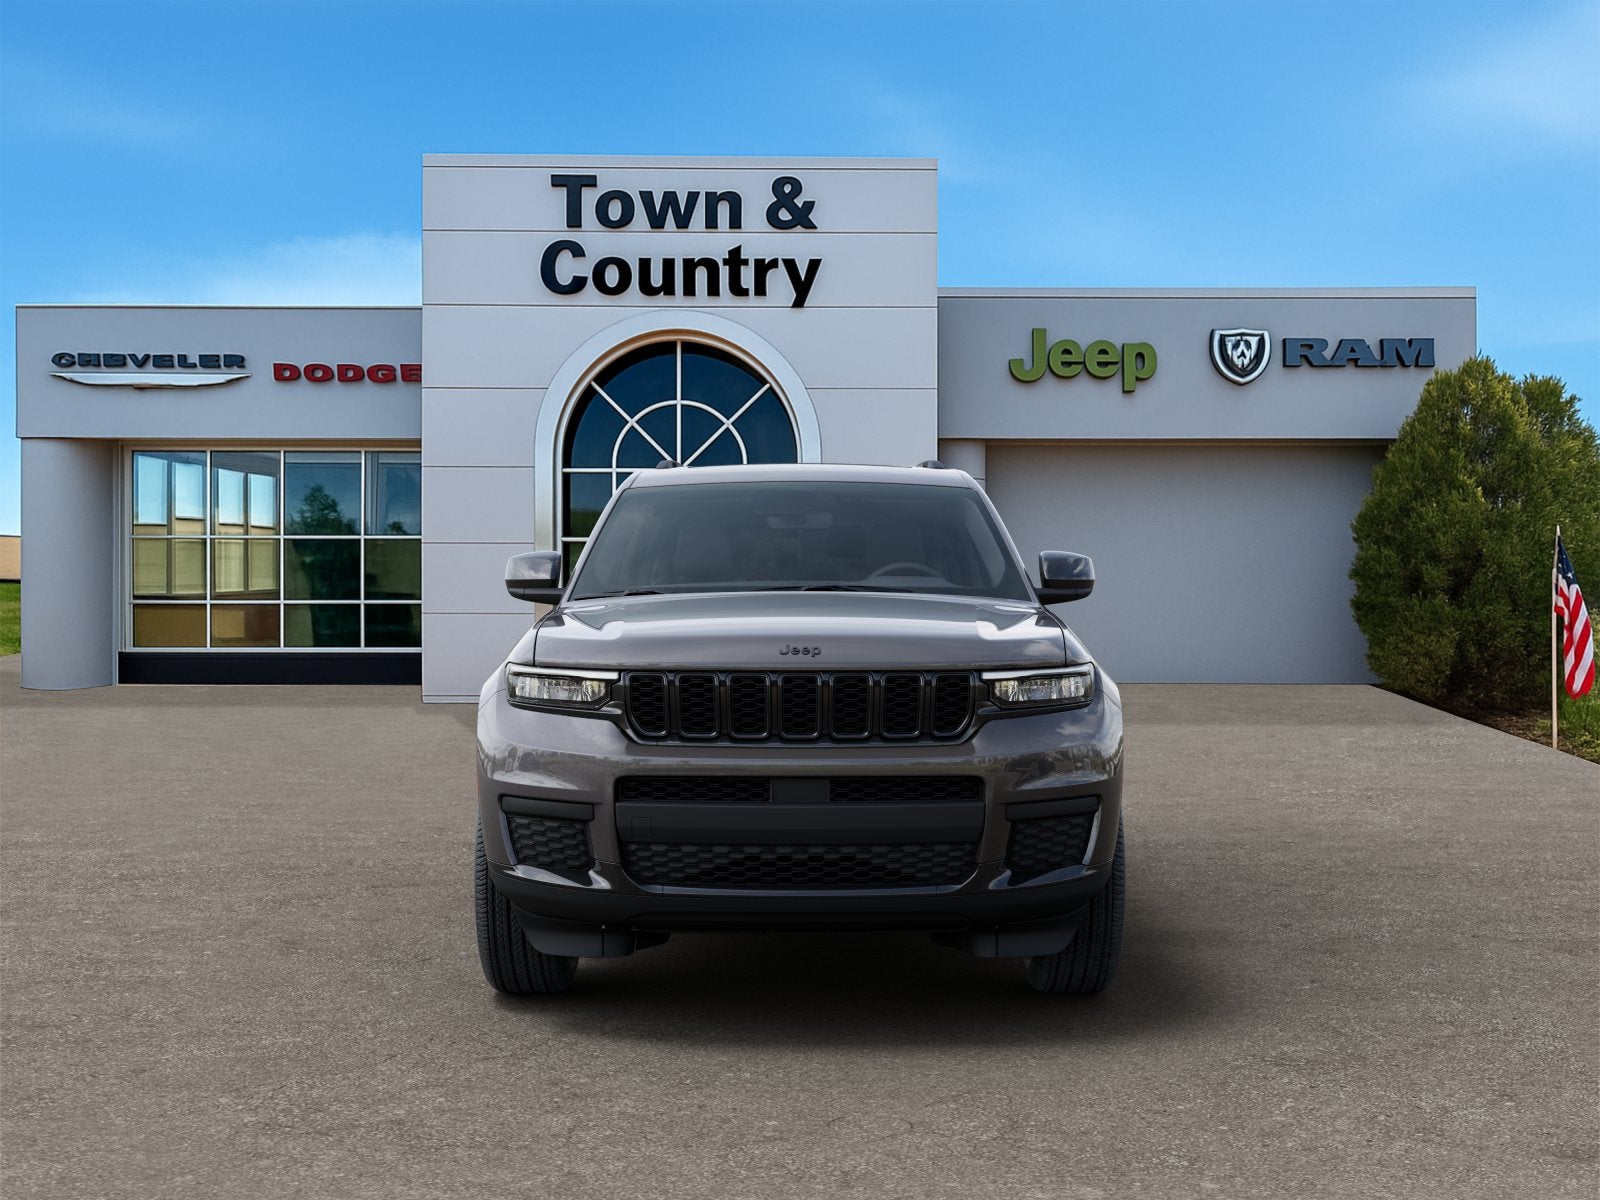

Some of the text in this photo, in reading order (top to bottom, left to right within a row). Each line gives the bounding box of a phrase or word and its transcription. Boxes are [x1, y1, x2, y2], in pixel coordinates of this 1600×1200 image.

[550, 174, 818, 230] Town &
[540, 239, 823, 309] Country
[273, 363, 422, 383] DODGE
[1008, 327, 1158, 393] Jeep
[1282, 337, 1436, 368] RAM
[778, 644, 822, 658] Jeep
